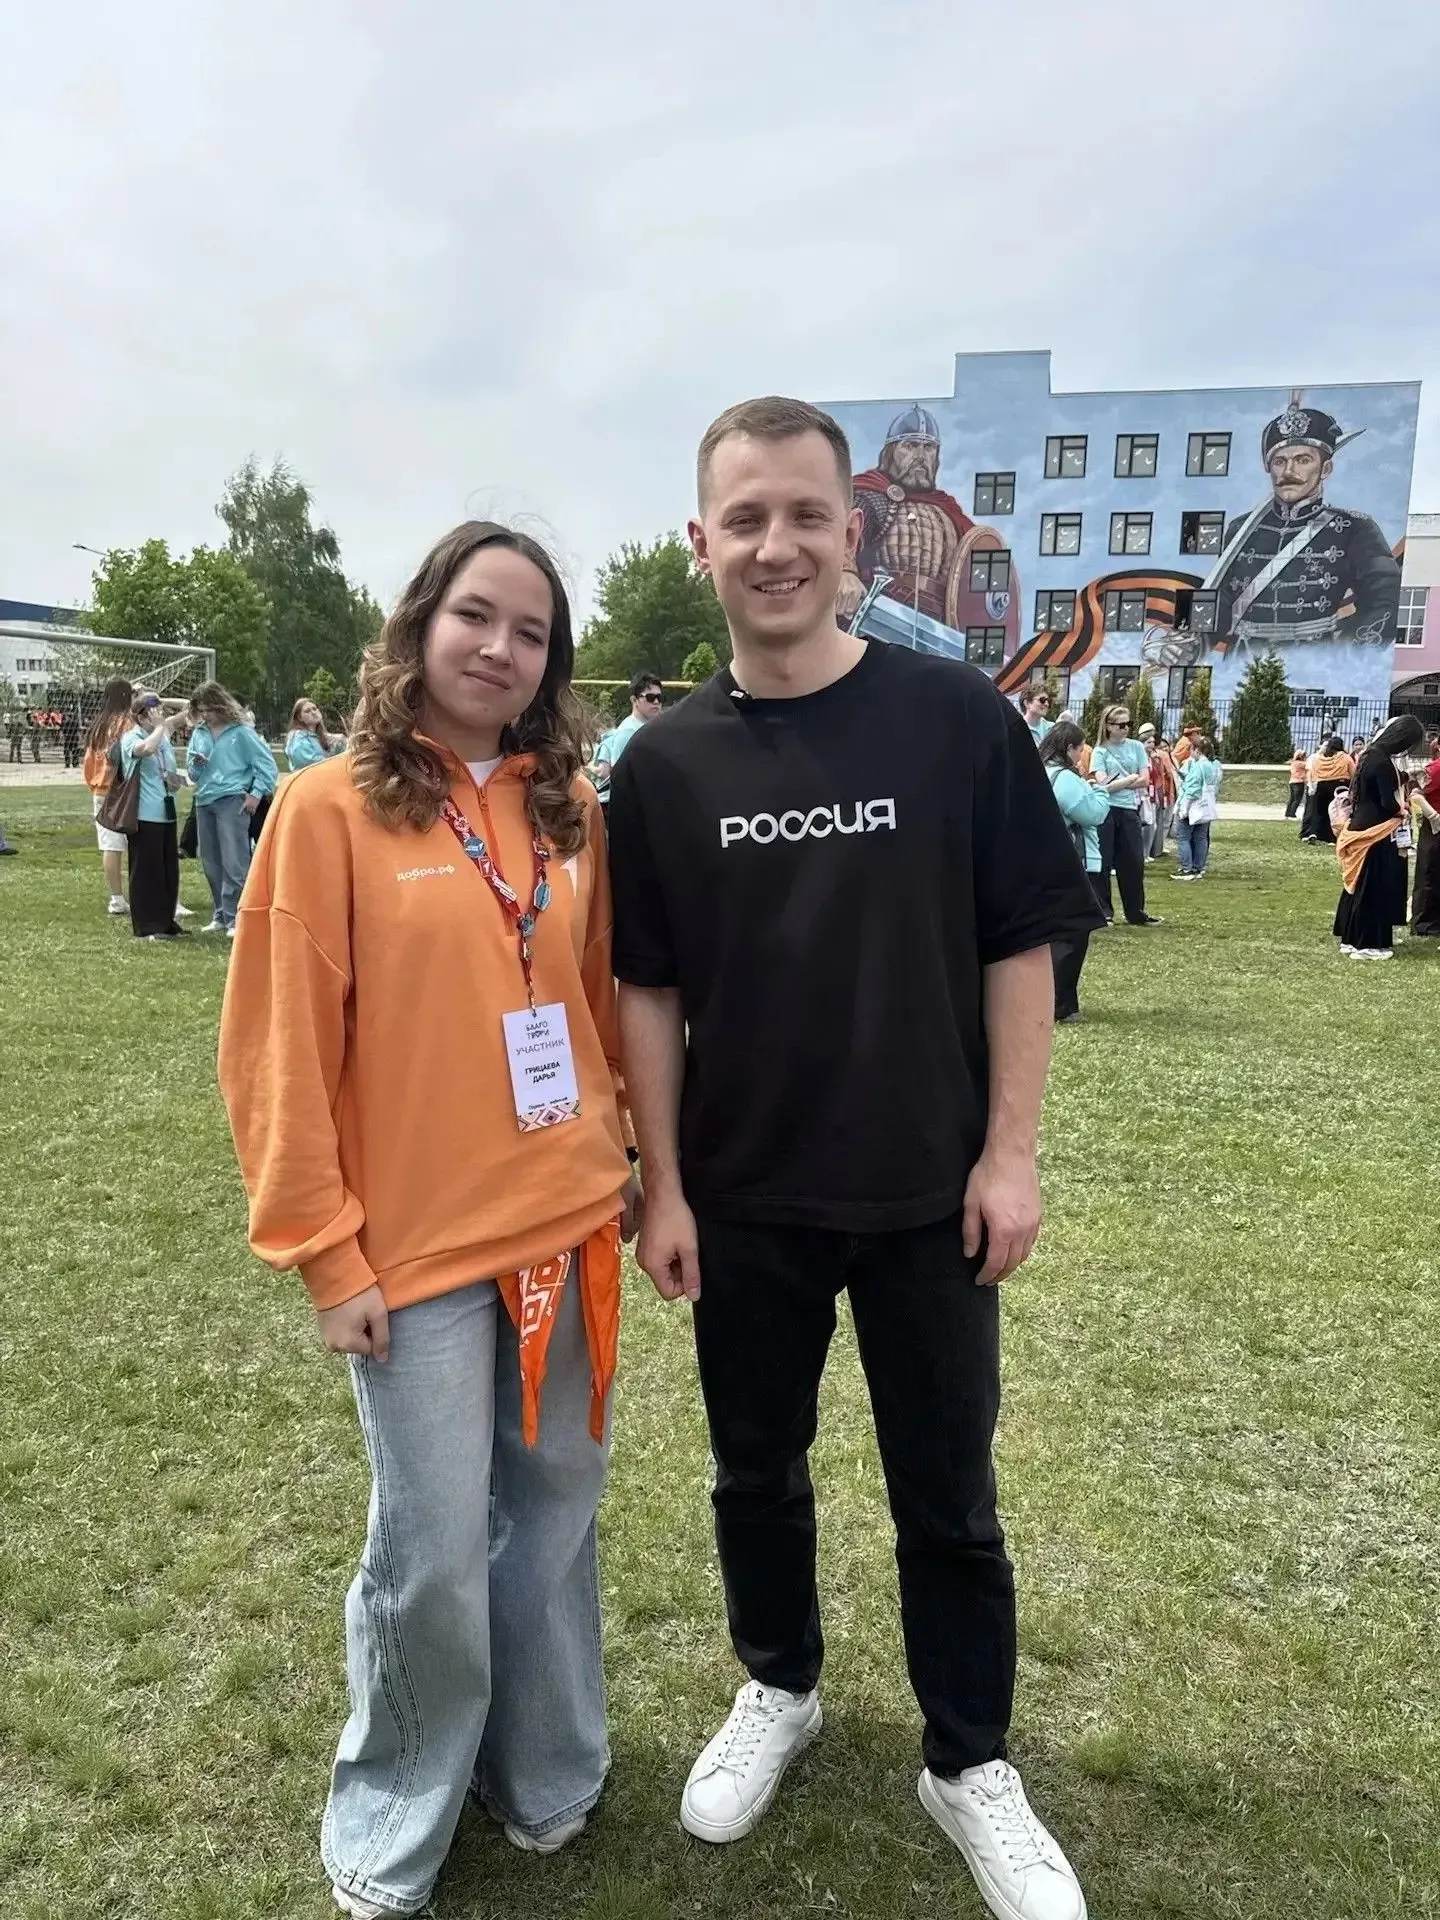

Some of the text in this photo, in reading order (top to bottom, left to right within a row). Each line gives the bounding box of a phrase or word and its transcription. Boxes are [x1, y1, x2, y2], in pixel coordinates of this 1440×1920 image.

[396, 864, 455, 882] добро.рф
[525, 1020, 549, 1031] БЛАГО
[516, 1038, 566, 1055] УЧАСТНИК
[525, 1061, 561, 1075] ГРИЦАЕВА
[533, 1071, 556, 1084] ДАРЬЯ
